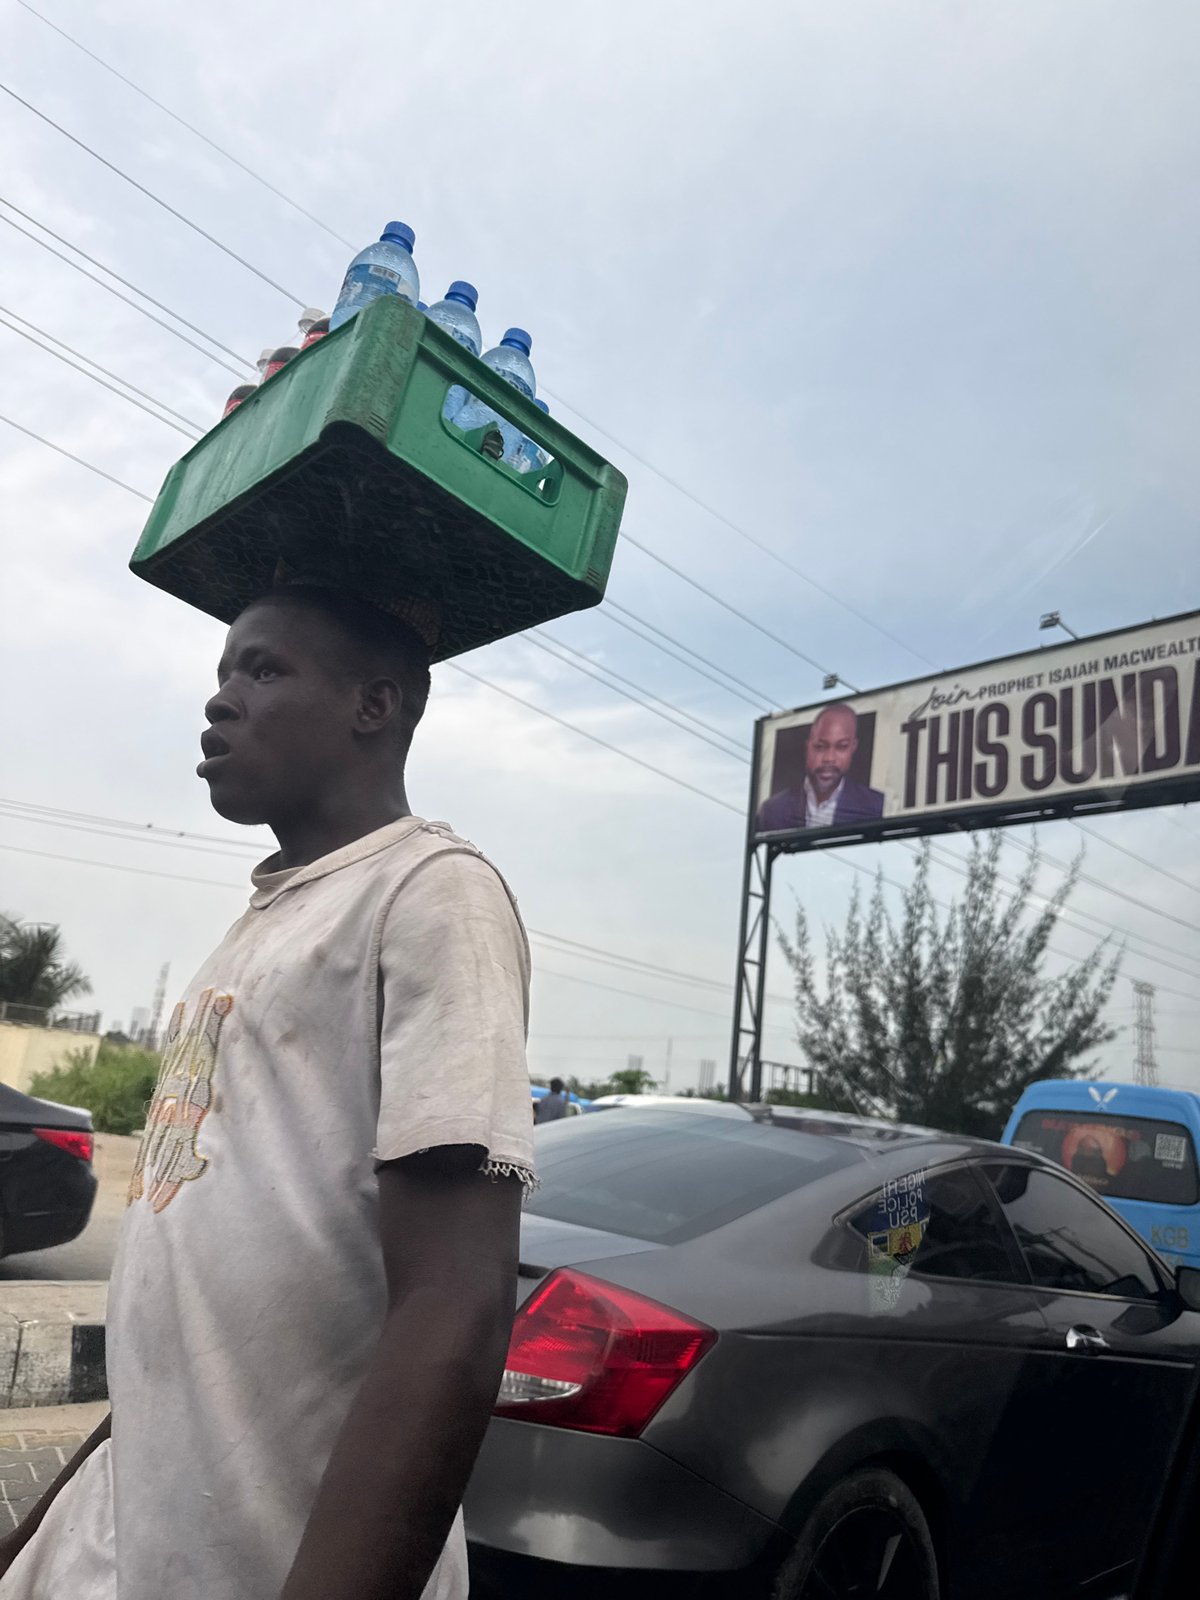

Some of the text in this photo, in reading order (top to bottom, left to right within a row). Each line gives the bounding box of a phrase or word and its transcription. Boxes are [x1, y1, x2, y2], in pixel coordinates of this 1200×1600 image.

[978, 672, 1044, 700] PROPHET
[1049, 659, 1099, 684] ISAIAH
[901, 702, 1010, 809] THIS
